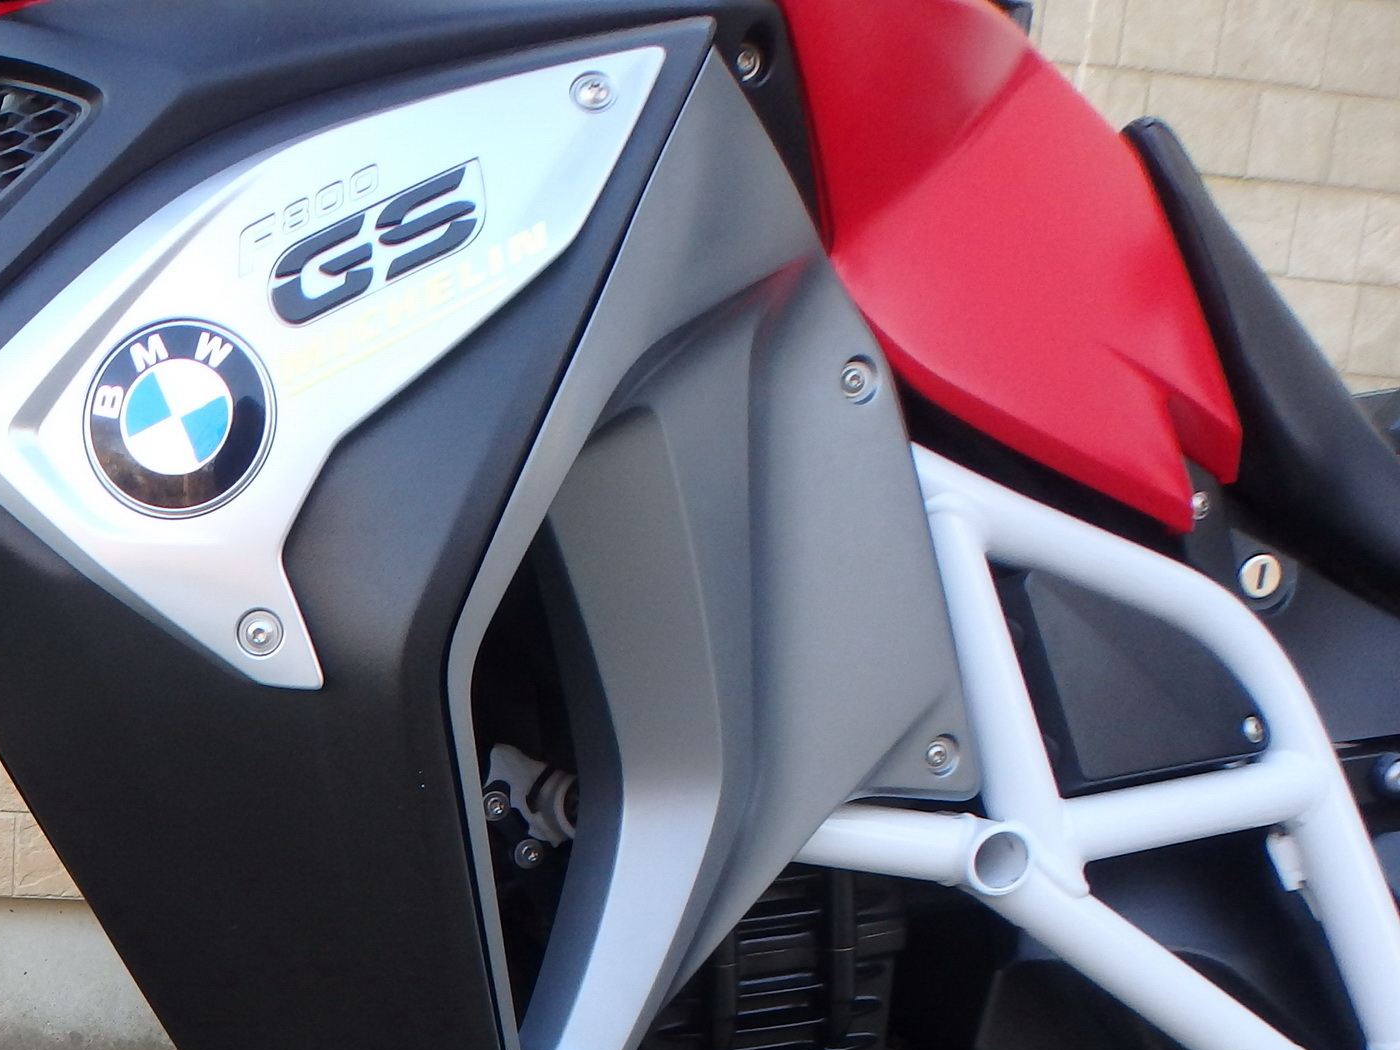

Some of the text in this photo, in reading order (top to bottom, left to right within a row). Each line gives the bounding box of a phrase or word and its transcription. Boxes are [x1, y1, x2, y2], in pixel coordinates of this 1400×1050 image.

[239, 163, 378, 277] F800
[271, 164, 478, 325] GS
[277, 221, 547, 385] MICHELIN
[92, 331, 233, 419] BMW
